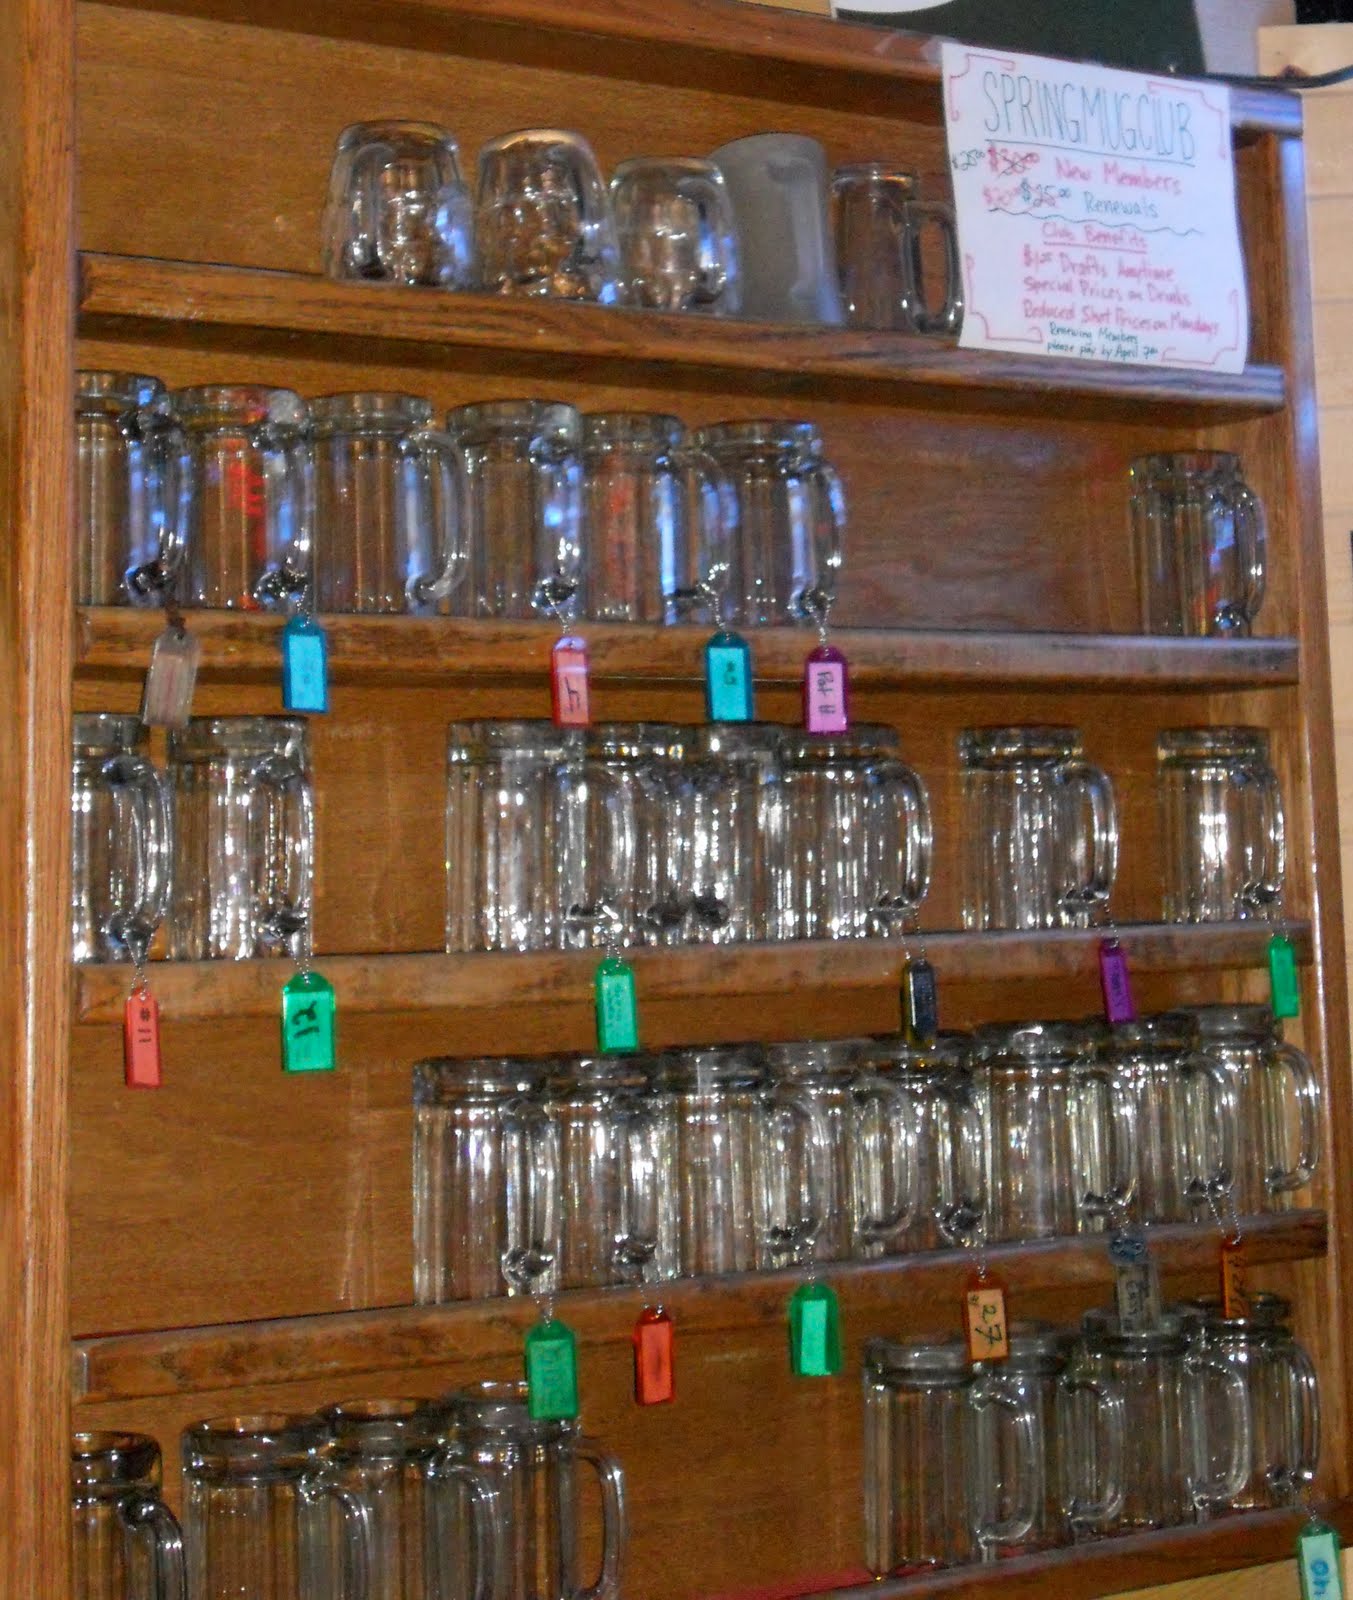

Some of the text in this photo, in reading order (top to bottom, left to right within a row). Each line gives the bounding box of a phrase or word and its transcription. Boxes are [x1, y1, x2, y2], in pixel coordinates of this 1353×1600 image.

[1054, 156, 1092, 182] New
[1102, 160, 1182, 196] Members
[1083, 190, 1159, 219] Renewals
[1022, 275, 1073, 295] Special
[1079, 278, 1123, 302] Prices
[1146, 281, 1192, 306] Drinks
[1022, 298, 1075, 321] Reduced
[1115, 306, 1152, 331] Prices
[1048, 319, 1093, 339] Renewing
[1047, 339, 1075, 354] please
[1080, 342, 1097, 357] pay
[1101, 344, 1113, 360] by
[1114, 343, 1139, 361] April
